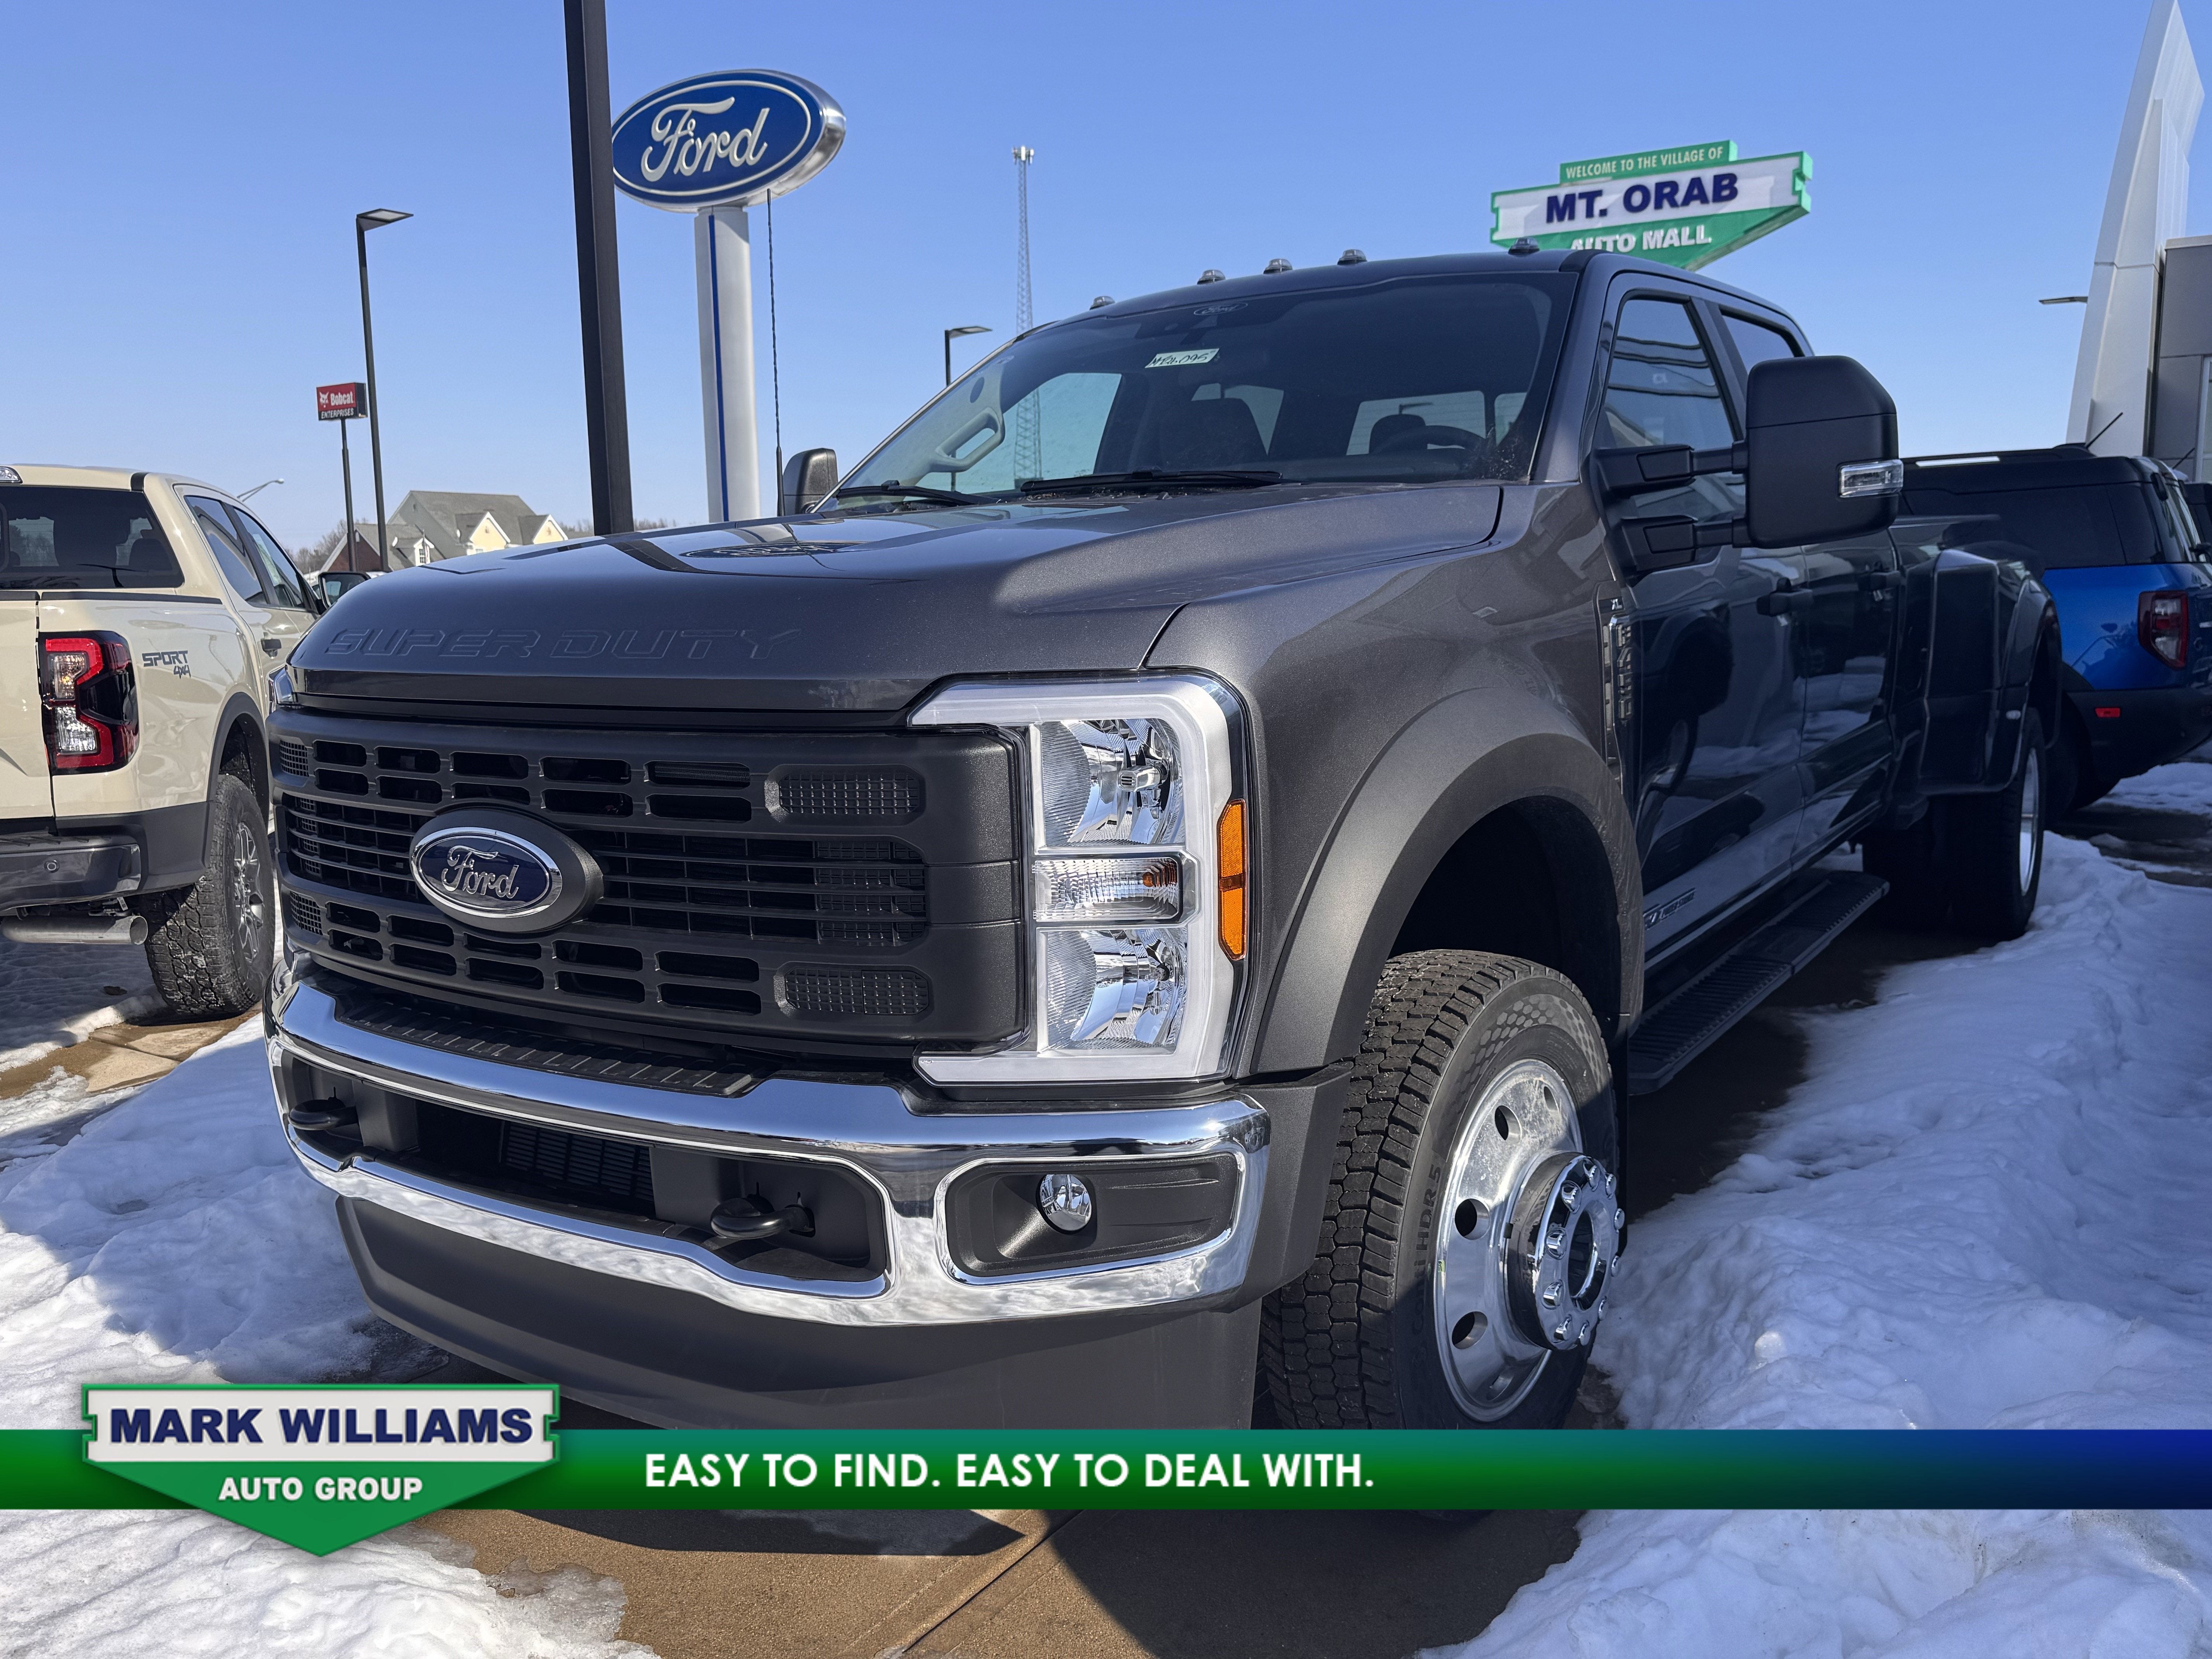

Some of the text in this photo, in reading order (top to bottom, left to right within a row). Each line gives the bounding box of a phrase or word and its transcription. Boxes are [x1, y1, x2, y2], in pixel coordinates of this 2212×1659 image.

[641, 96, 770, 181] Ford
[1566, 146, 1723, 179] WELCOME TO THE VILLAGE OF
[1546, 173, 1739, 224] MT. ORAB
[1642, 225, 1712, 250] MALL
[330, 391, 354, 406] Bobcat
[321, 408, 354, 419] ENTERPRISES
[1610, 598, 1623, 610] XL
[325, 629, 801, 659] SUPER DUTY
[142, 650, 188, 667] SPORT
[441, 845, 519, 899] Ford
